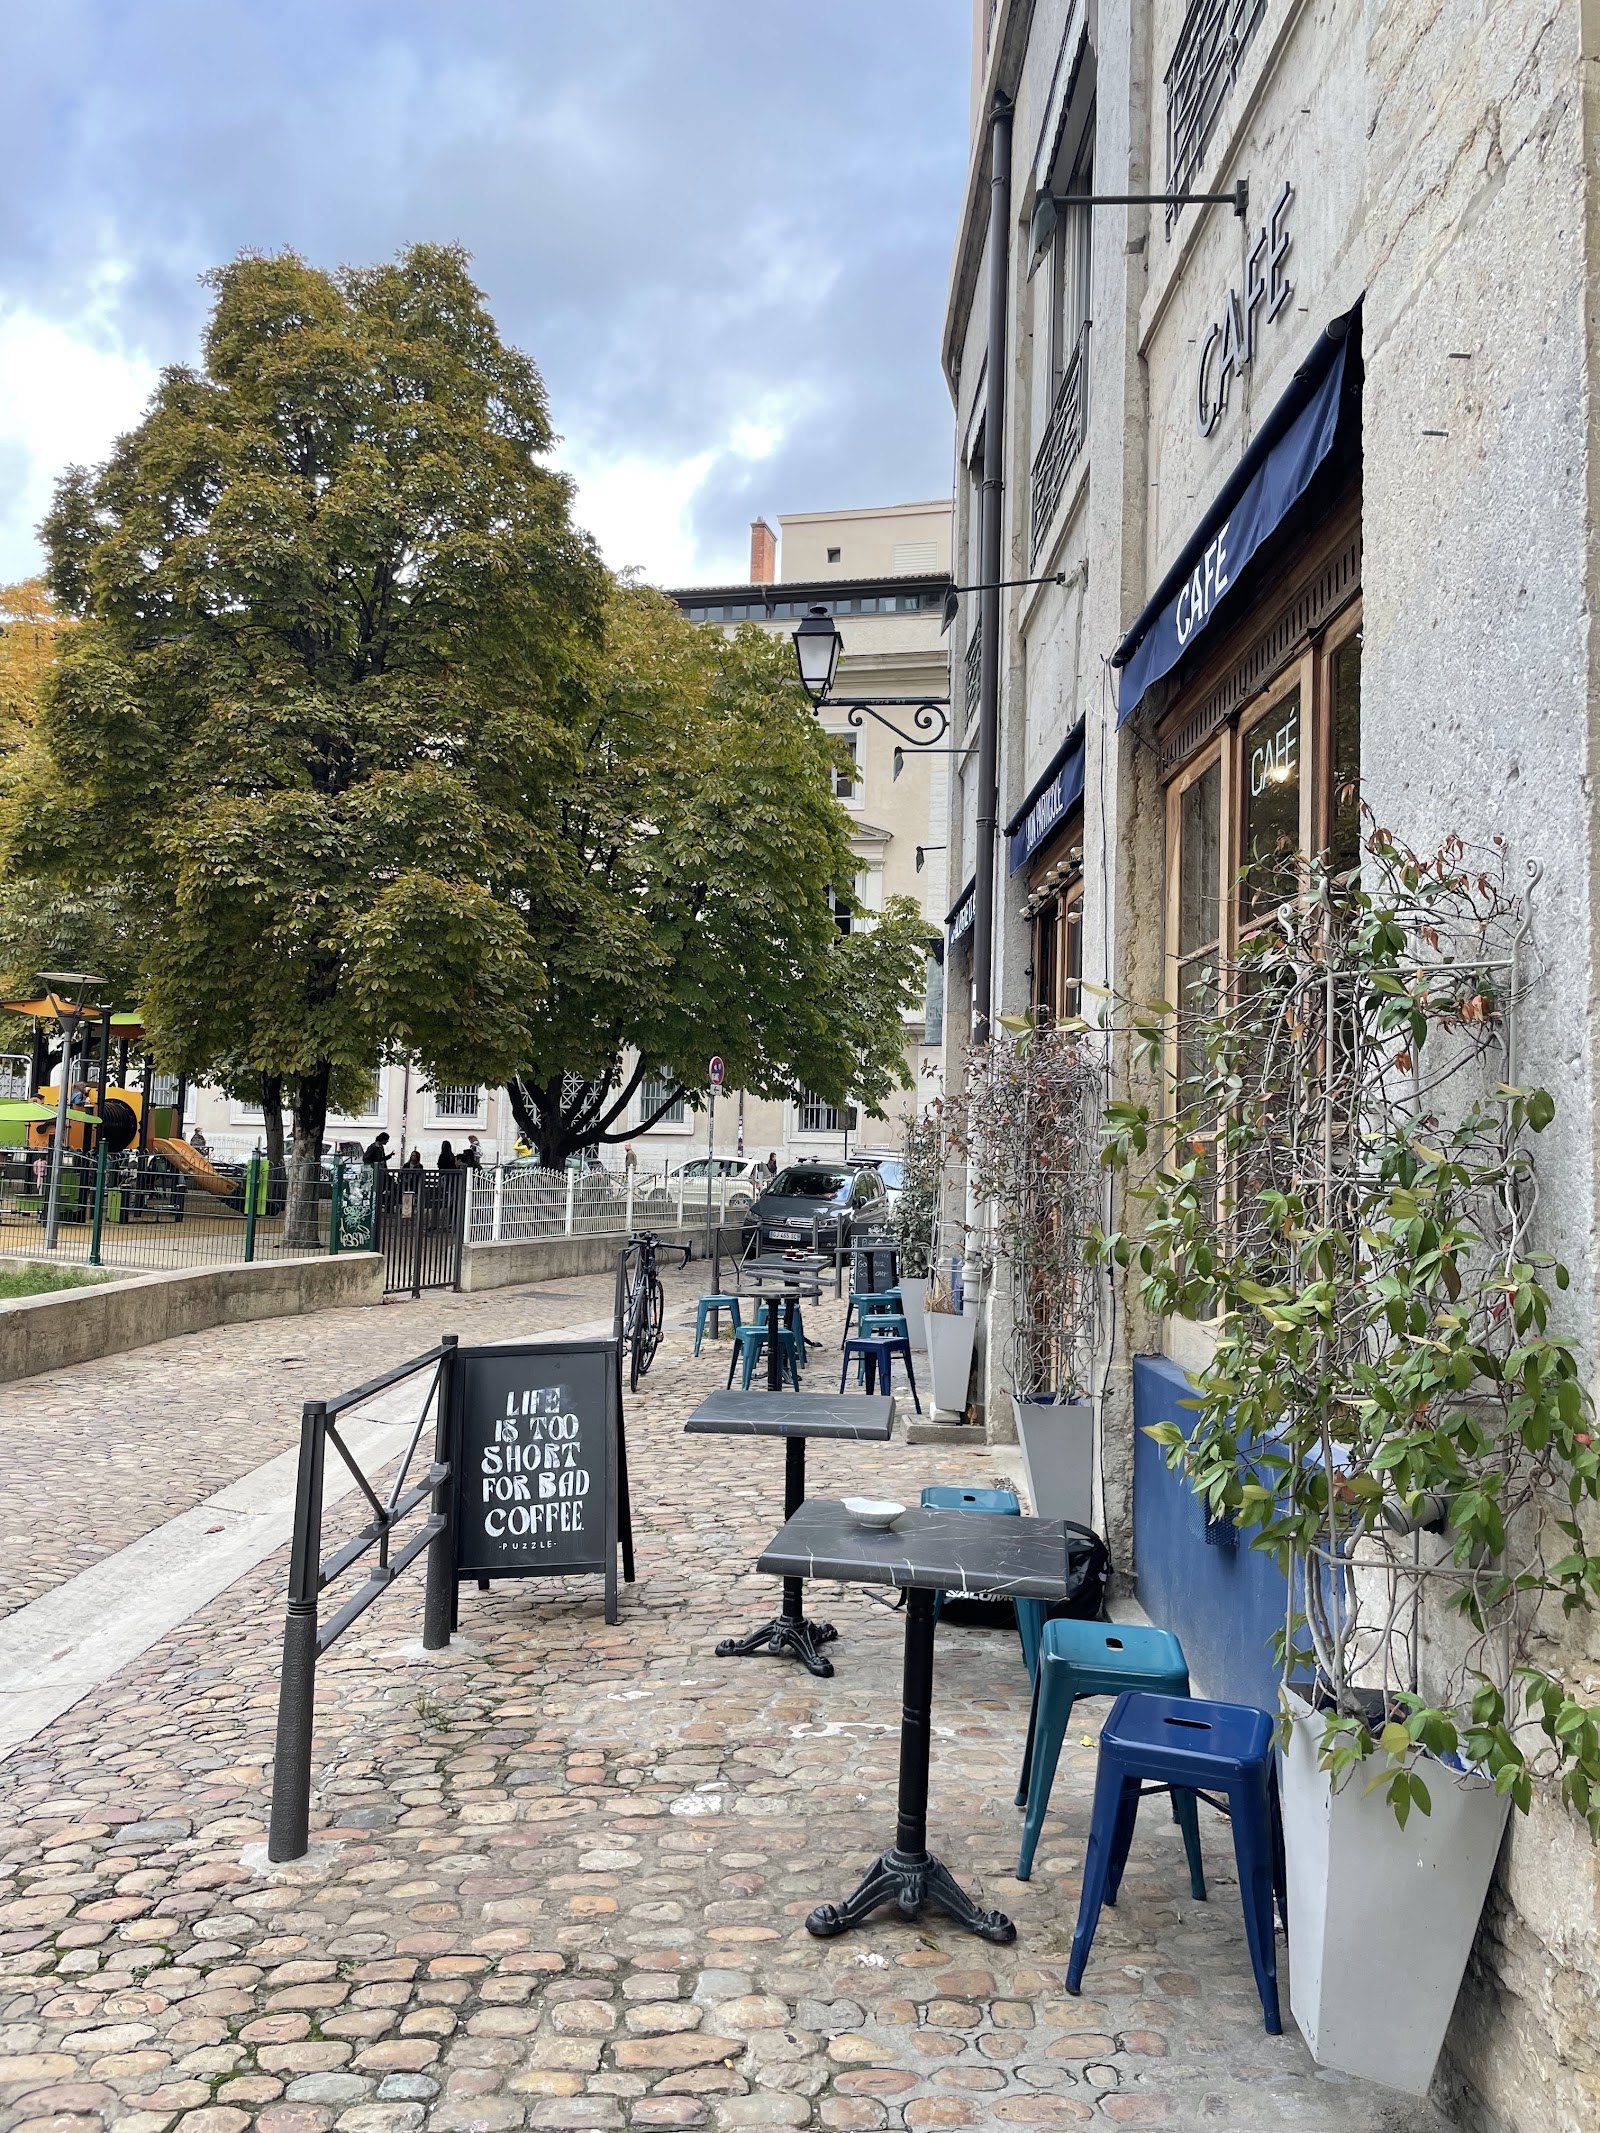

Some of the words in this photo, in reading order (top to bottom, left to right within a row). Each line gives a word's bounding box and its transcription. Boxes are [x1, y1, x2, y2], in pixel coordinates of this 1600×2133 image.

[1197, 180, 1290, 438] CAFE
[1175, 521, 1231, 645] CAFE
[1251, 706, 1297, 797] CAFÉ
[506, 1387, 561, 1417] LIFE
[494, 1418, 519, 1443] IS
[529, 1413, 580, 1441] TOO
[481, 1441, 581, 1475] SHORT
[482, 1475, 532, 1503] FOR
[538, 1469, 591, 1499] BAD
